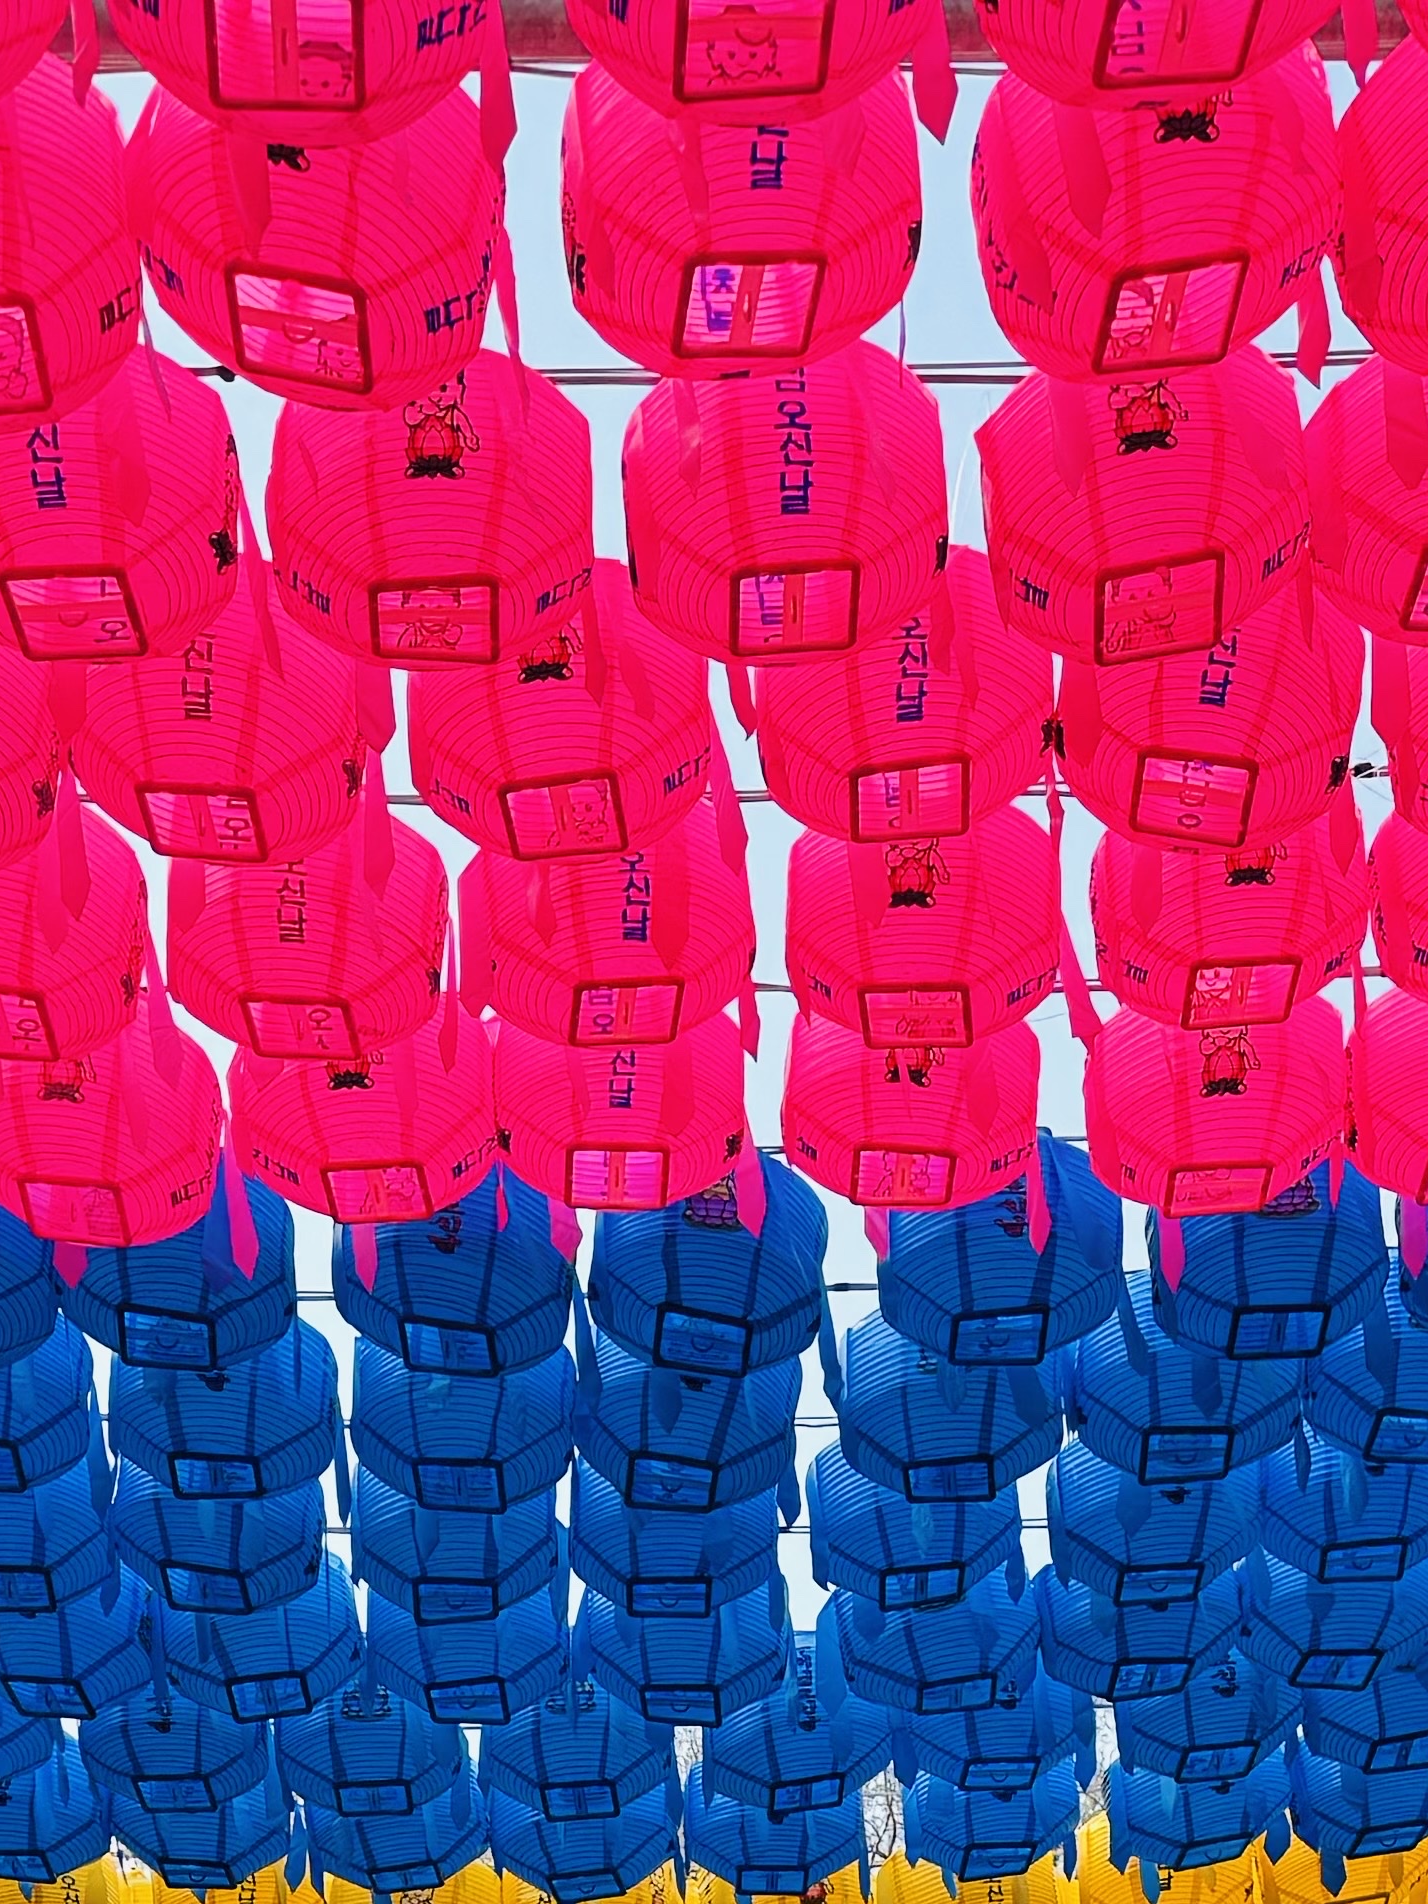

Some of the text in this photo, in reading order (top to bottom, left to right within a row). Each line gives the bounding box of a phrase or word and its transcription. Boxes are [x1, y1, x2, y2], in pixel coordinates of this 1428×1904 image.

[27, 425, 66, 508] 신날
[776, 401, 813, 514] 오신날
[182, 637, 214, 720] 신날
[1199, 632, 1237, 707] 신날
[620, 852, 650, 942] 오신날
[610, 1051, 635, 1108] 신날
